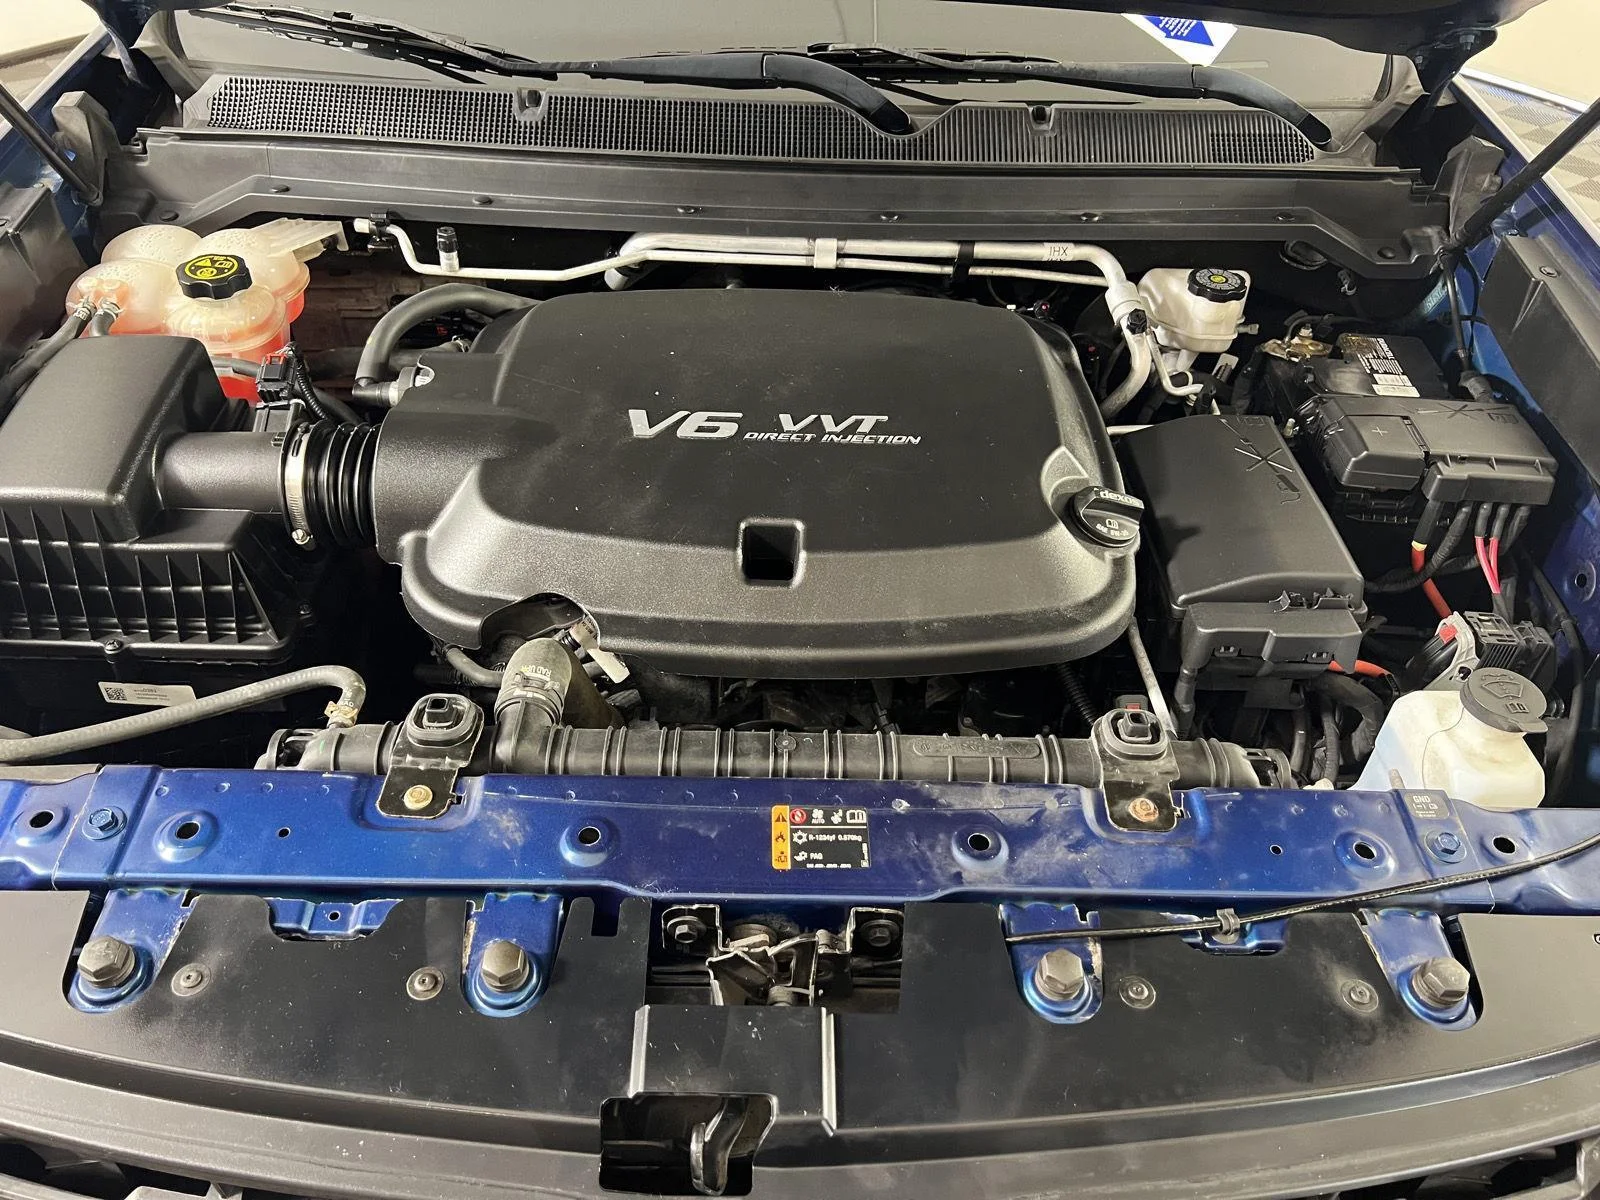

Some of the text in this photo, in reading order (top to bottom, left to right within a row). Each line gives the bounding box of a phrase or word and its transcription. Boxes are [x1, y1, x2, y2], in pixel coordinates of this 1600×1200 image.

[628, 409, 743, 438] V6
[778, 413, 889, 433] VVT
[743, 432, 921, 444] DIRECT INJECTION
[1413, 795, 1431, 803] GND
[809, 852, 823, 860] PAG
